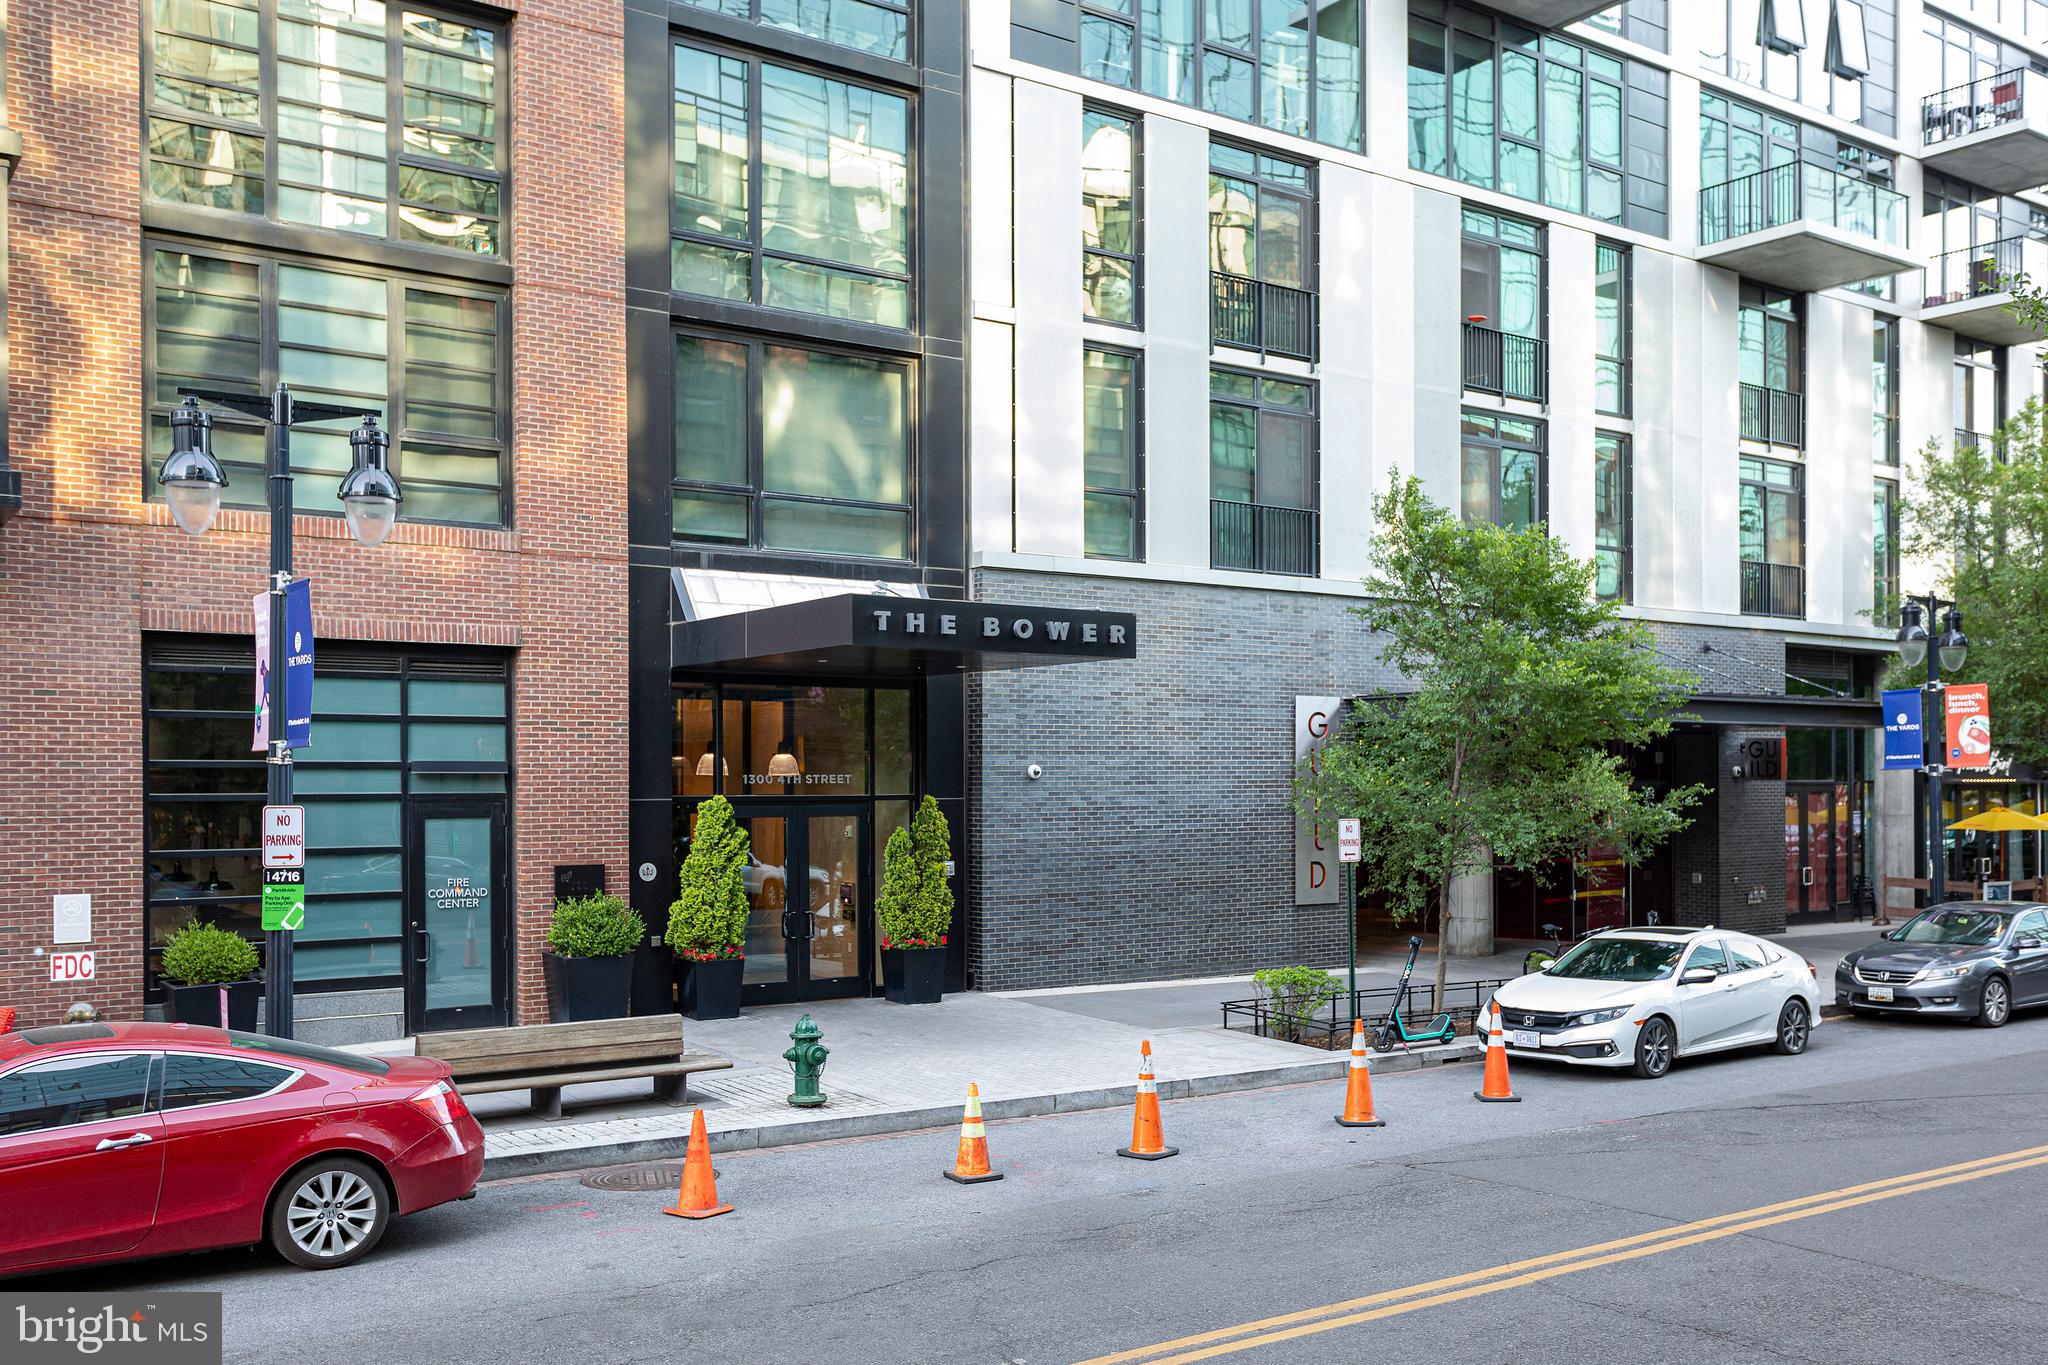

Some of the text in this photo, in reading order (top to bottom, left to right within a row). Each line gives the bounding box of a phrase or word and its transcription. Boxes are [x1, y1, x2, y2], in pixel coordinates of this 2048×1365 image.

[873, 610, 1126, 644] THE BOWER
[288, 654, 312, 667] THE YARDS
[1899, 723, 1920, 731] YARDS
[742, 774, 852, 785] 1300 4TH STREET
[276, 814, 291, 827] NO
[1345, 825, 1353, 833] NO
[265, 834, 302, 847] PARKING
[447, 877, 470, 888] FIRE
[428, 887, 488, 899] COMMAND
[437, 898, 480, 909] CENTER
[52, 954, 92, 979] FDC
